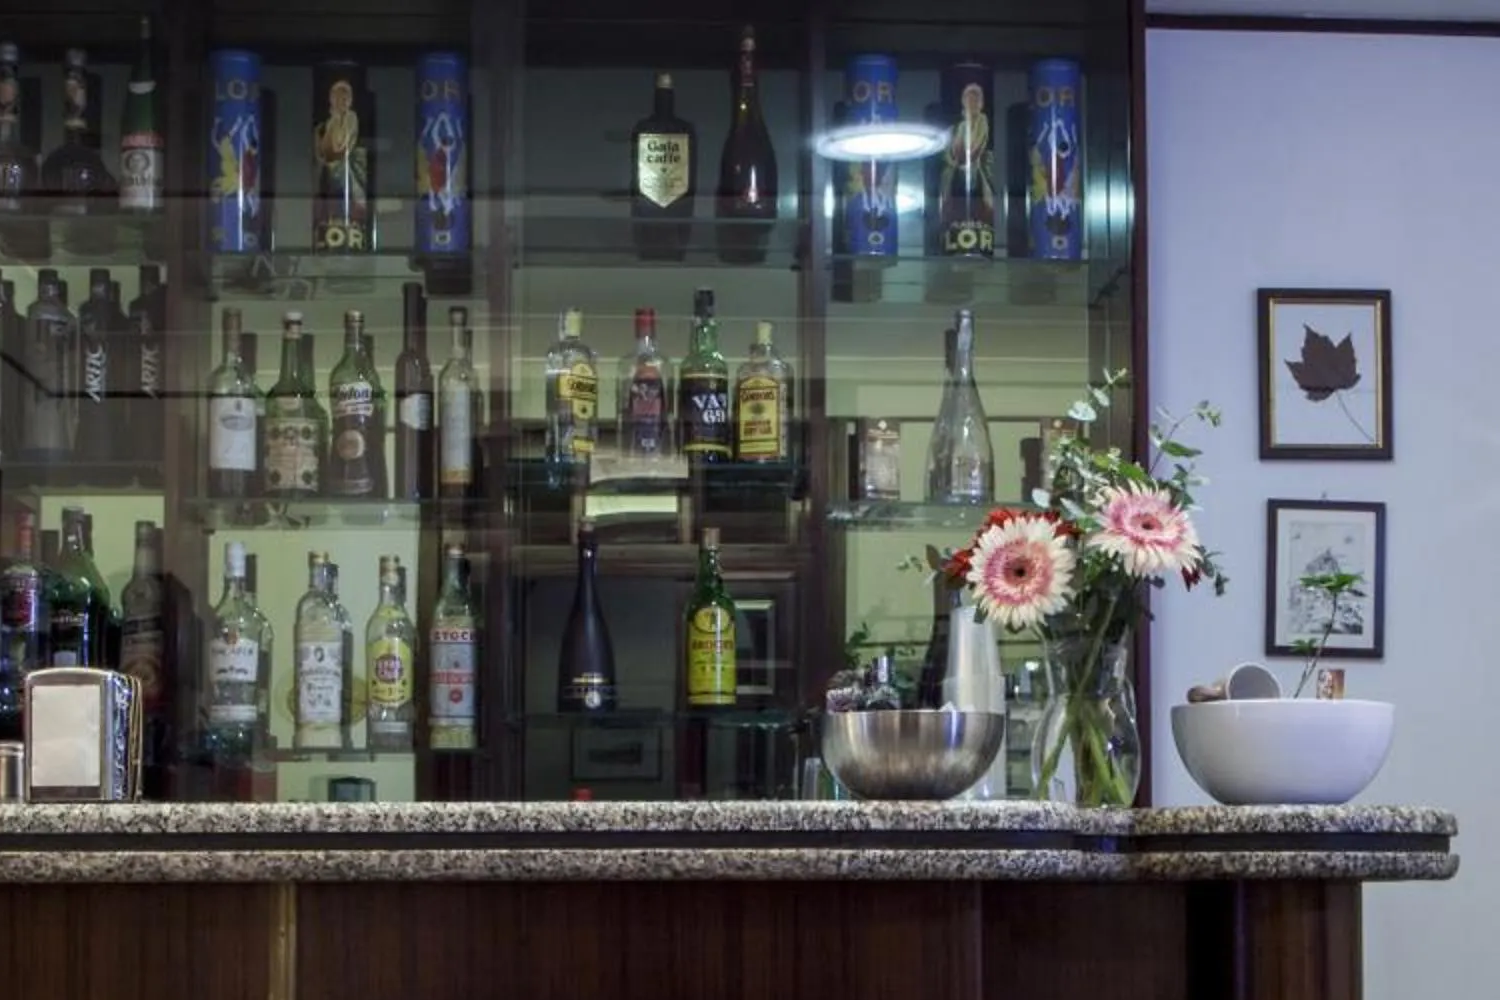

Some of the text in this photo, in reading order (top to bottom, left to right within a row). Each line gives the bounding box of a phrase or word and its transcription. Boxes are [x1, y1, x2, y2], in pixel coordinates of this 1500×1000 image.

[944, 230, 993, 251] LOR
[692, 393, 727, 410] VAT
[702, 409, 726, 424] 69
